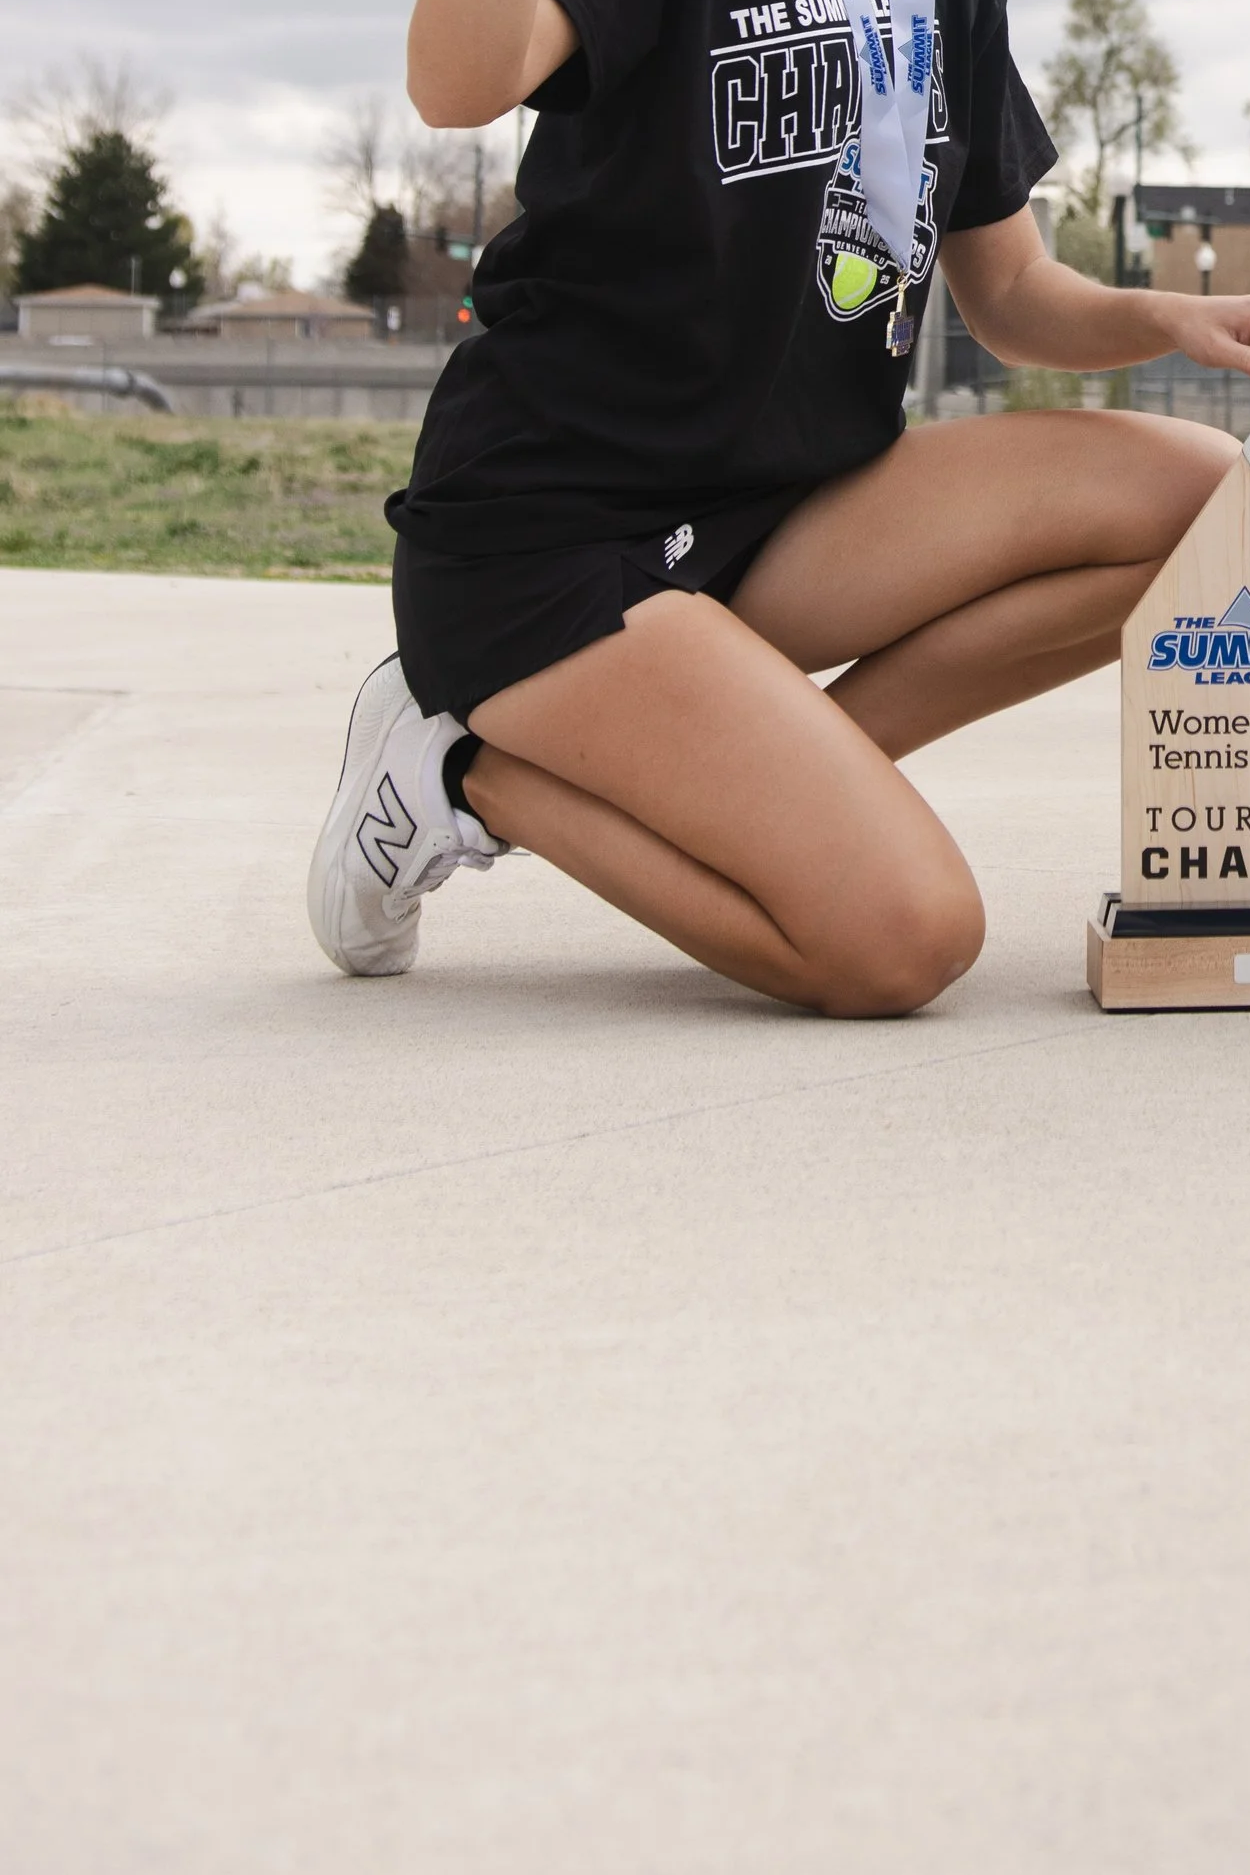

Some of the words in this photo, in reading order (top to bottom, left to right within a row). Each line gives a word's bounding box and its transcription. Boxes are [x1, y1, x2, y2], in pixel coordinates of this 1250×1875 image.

[730, 1, 791, 39] THE
[859, 15, 887, 96] SUMMIT
[911, 14, 927, 96] SUMMIT
[1173, 617, 1216, 629] THE
[1149, 744, 1249, 770] Tennis
